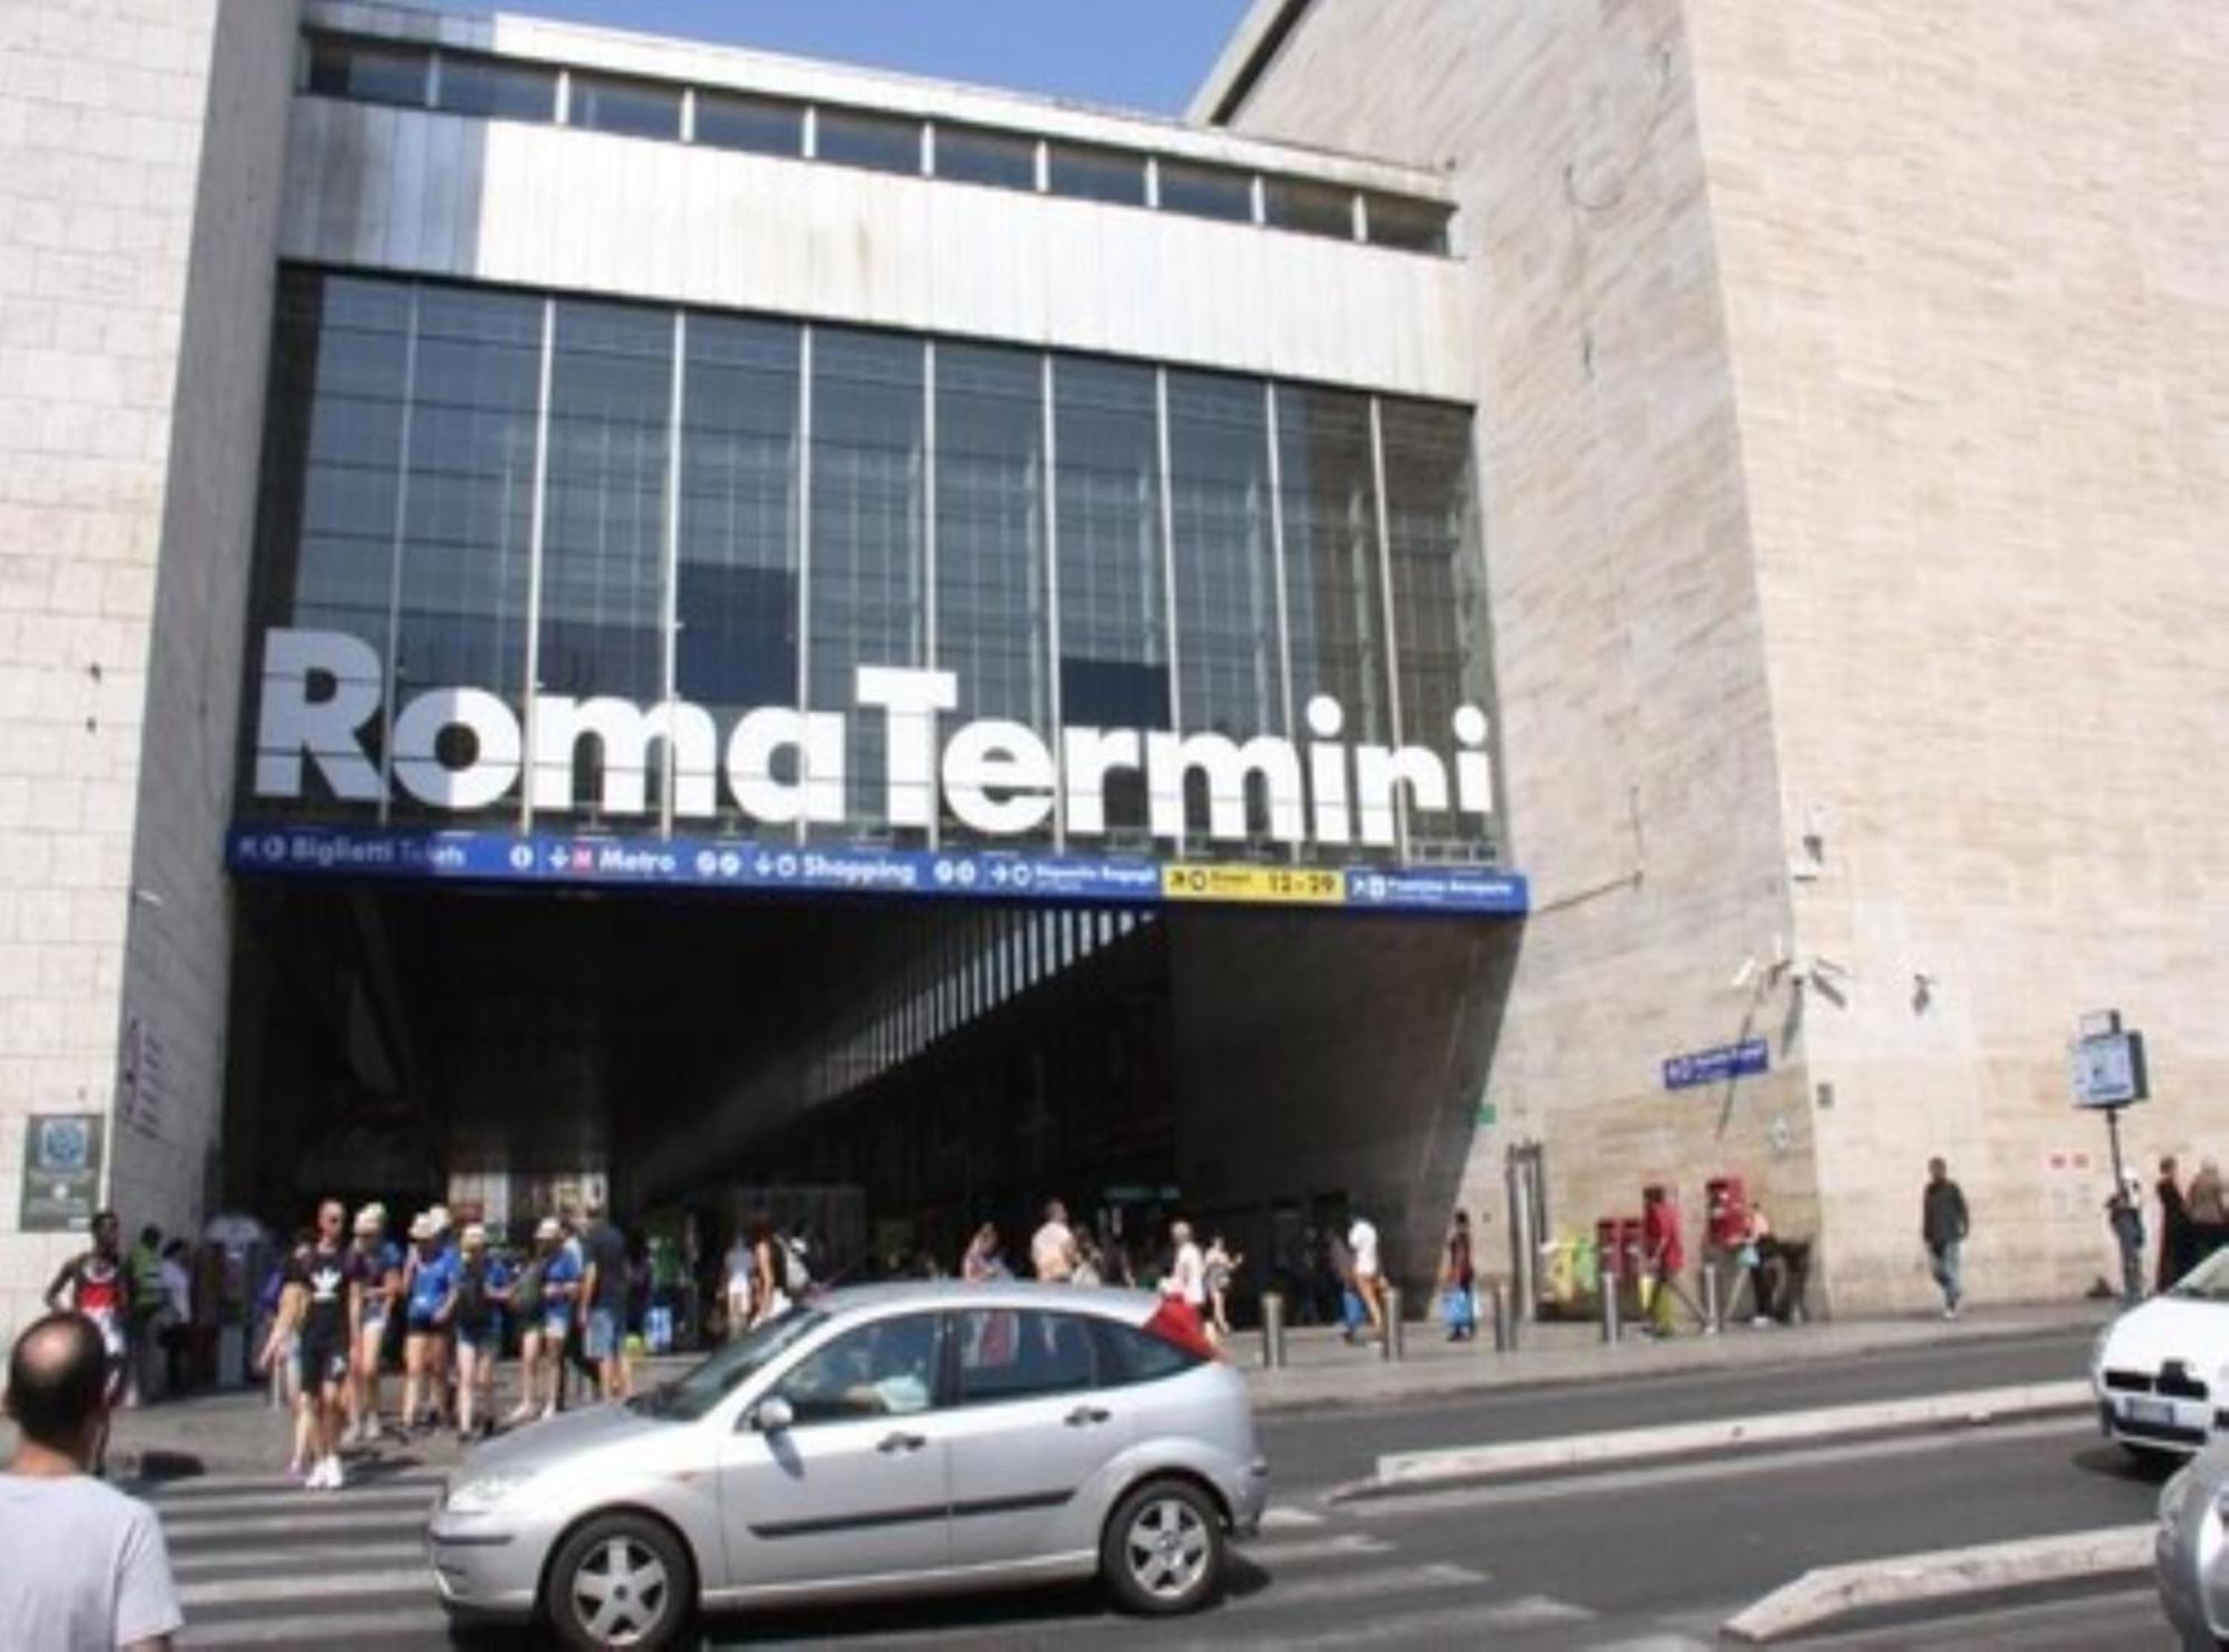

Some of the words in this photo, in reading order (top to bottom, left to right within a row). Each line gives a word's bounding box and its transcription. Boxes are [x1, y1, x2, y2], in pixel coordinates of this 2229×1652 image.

[255, 627, 846, 822] Roma
[856, 666, 1490, 847] Termini
[599, 848, 676, 874] Metro
[802, 853, 917, 887] Shopping
